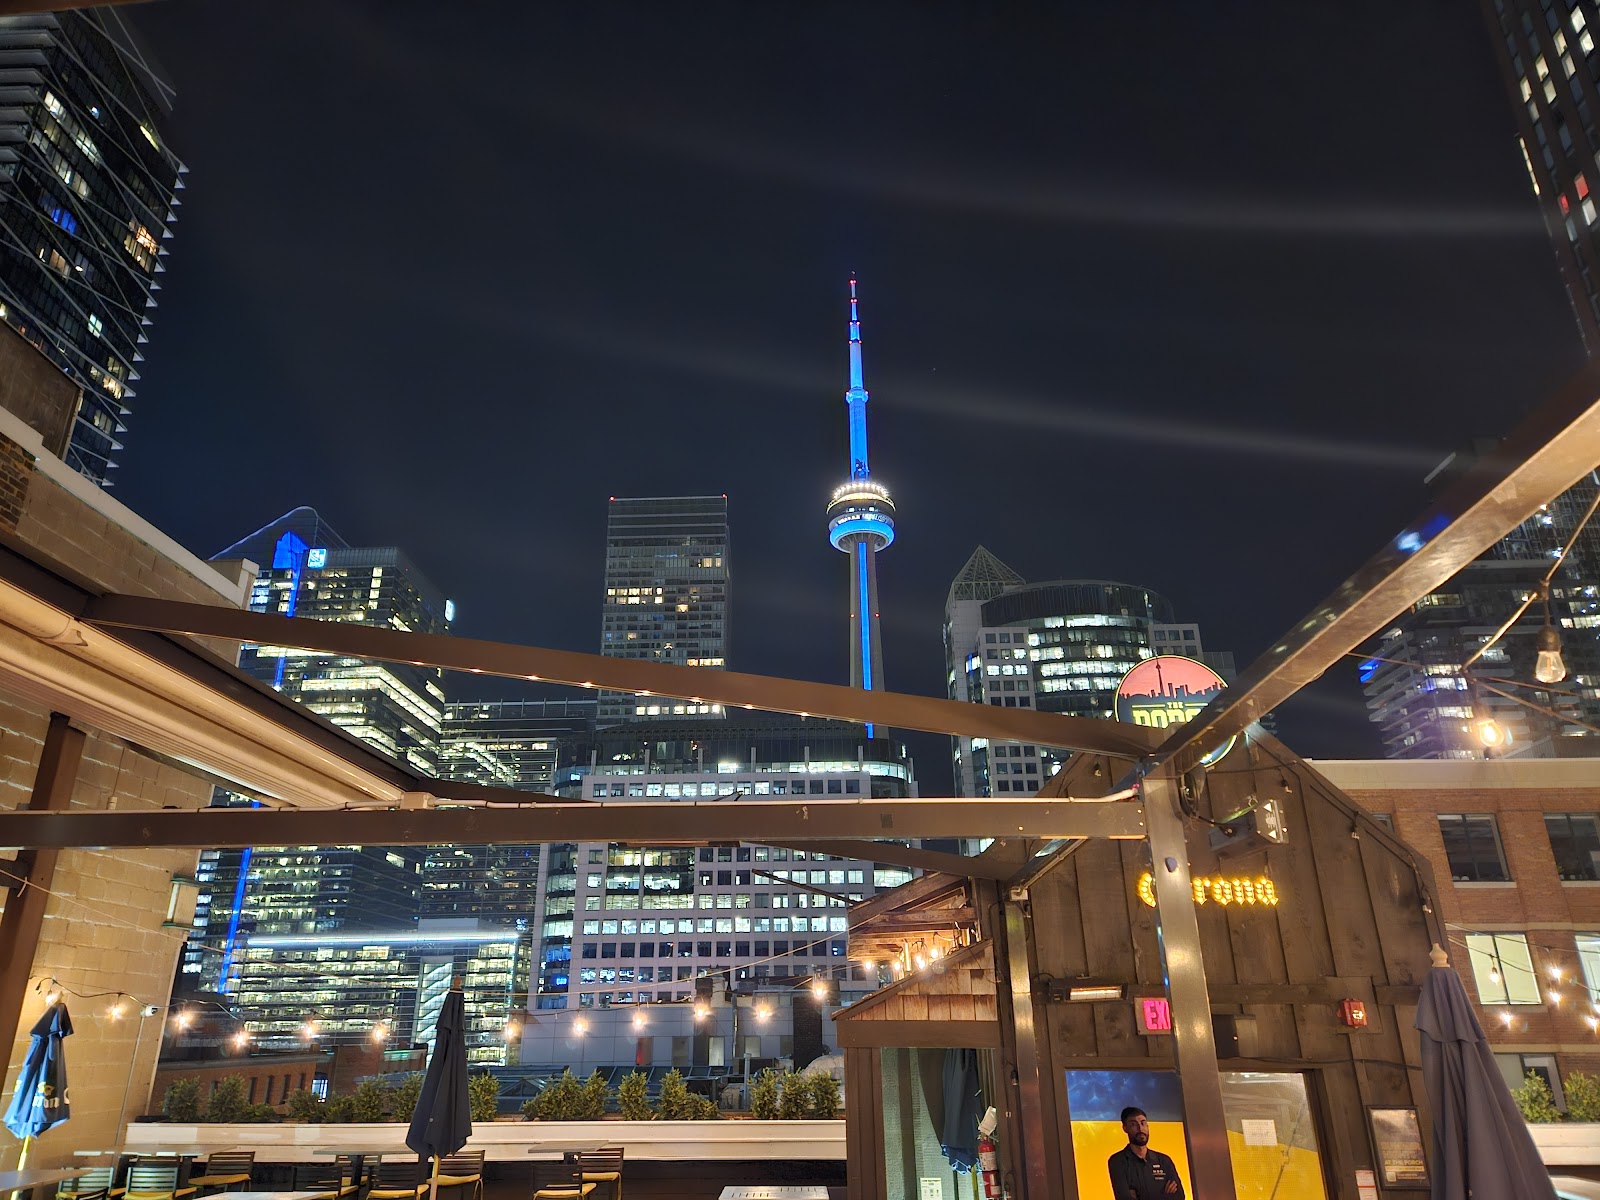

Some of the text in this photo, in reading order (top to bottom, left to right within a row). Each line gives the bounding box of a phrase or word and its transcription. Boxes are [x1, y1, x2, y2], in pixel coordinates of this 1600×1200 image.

[1132, 708, 1202, 729] POR
[1137, 873, 1279, 907] Crona
[1143, 1000, 1171, 1030] EXI
